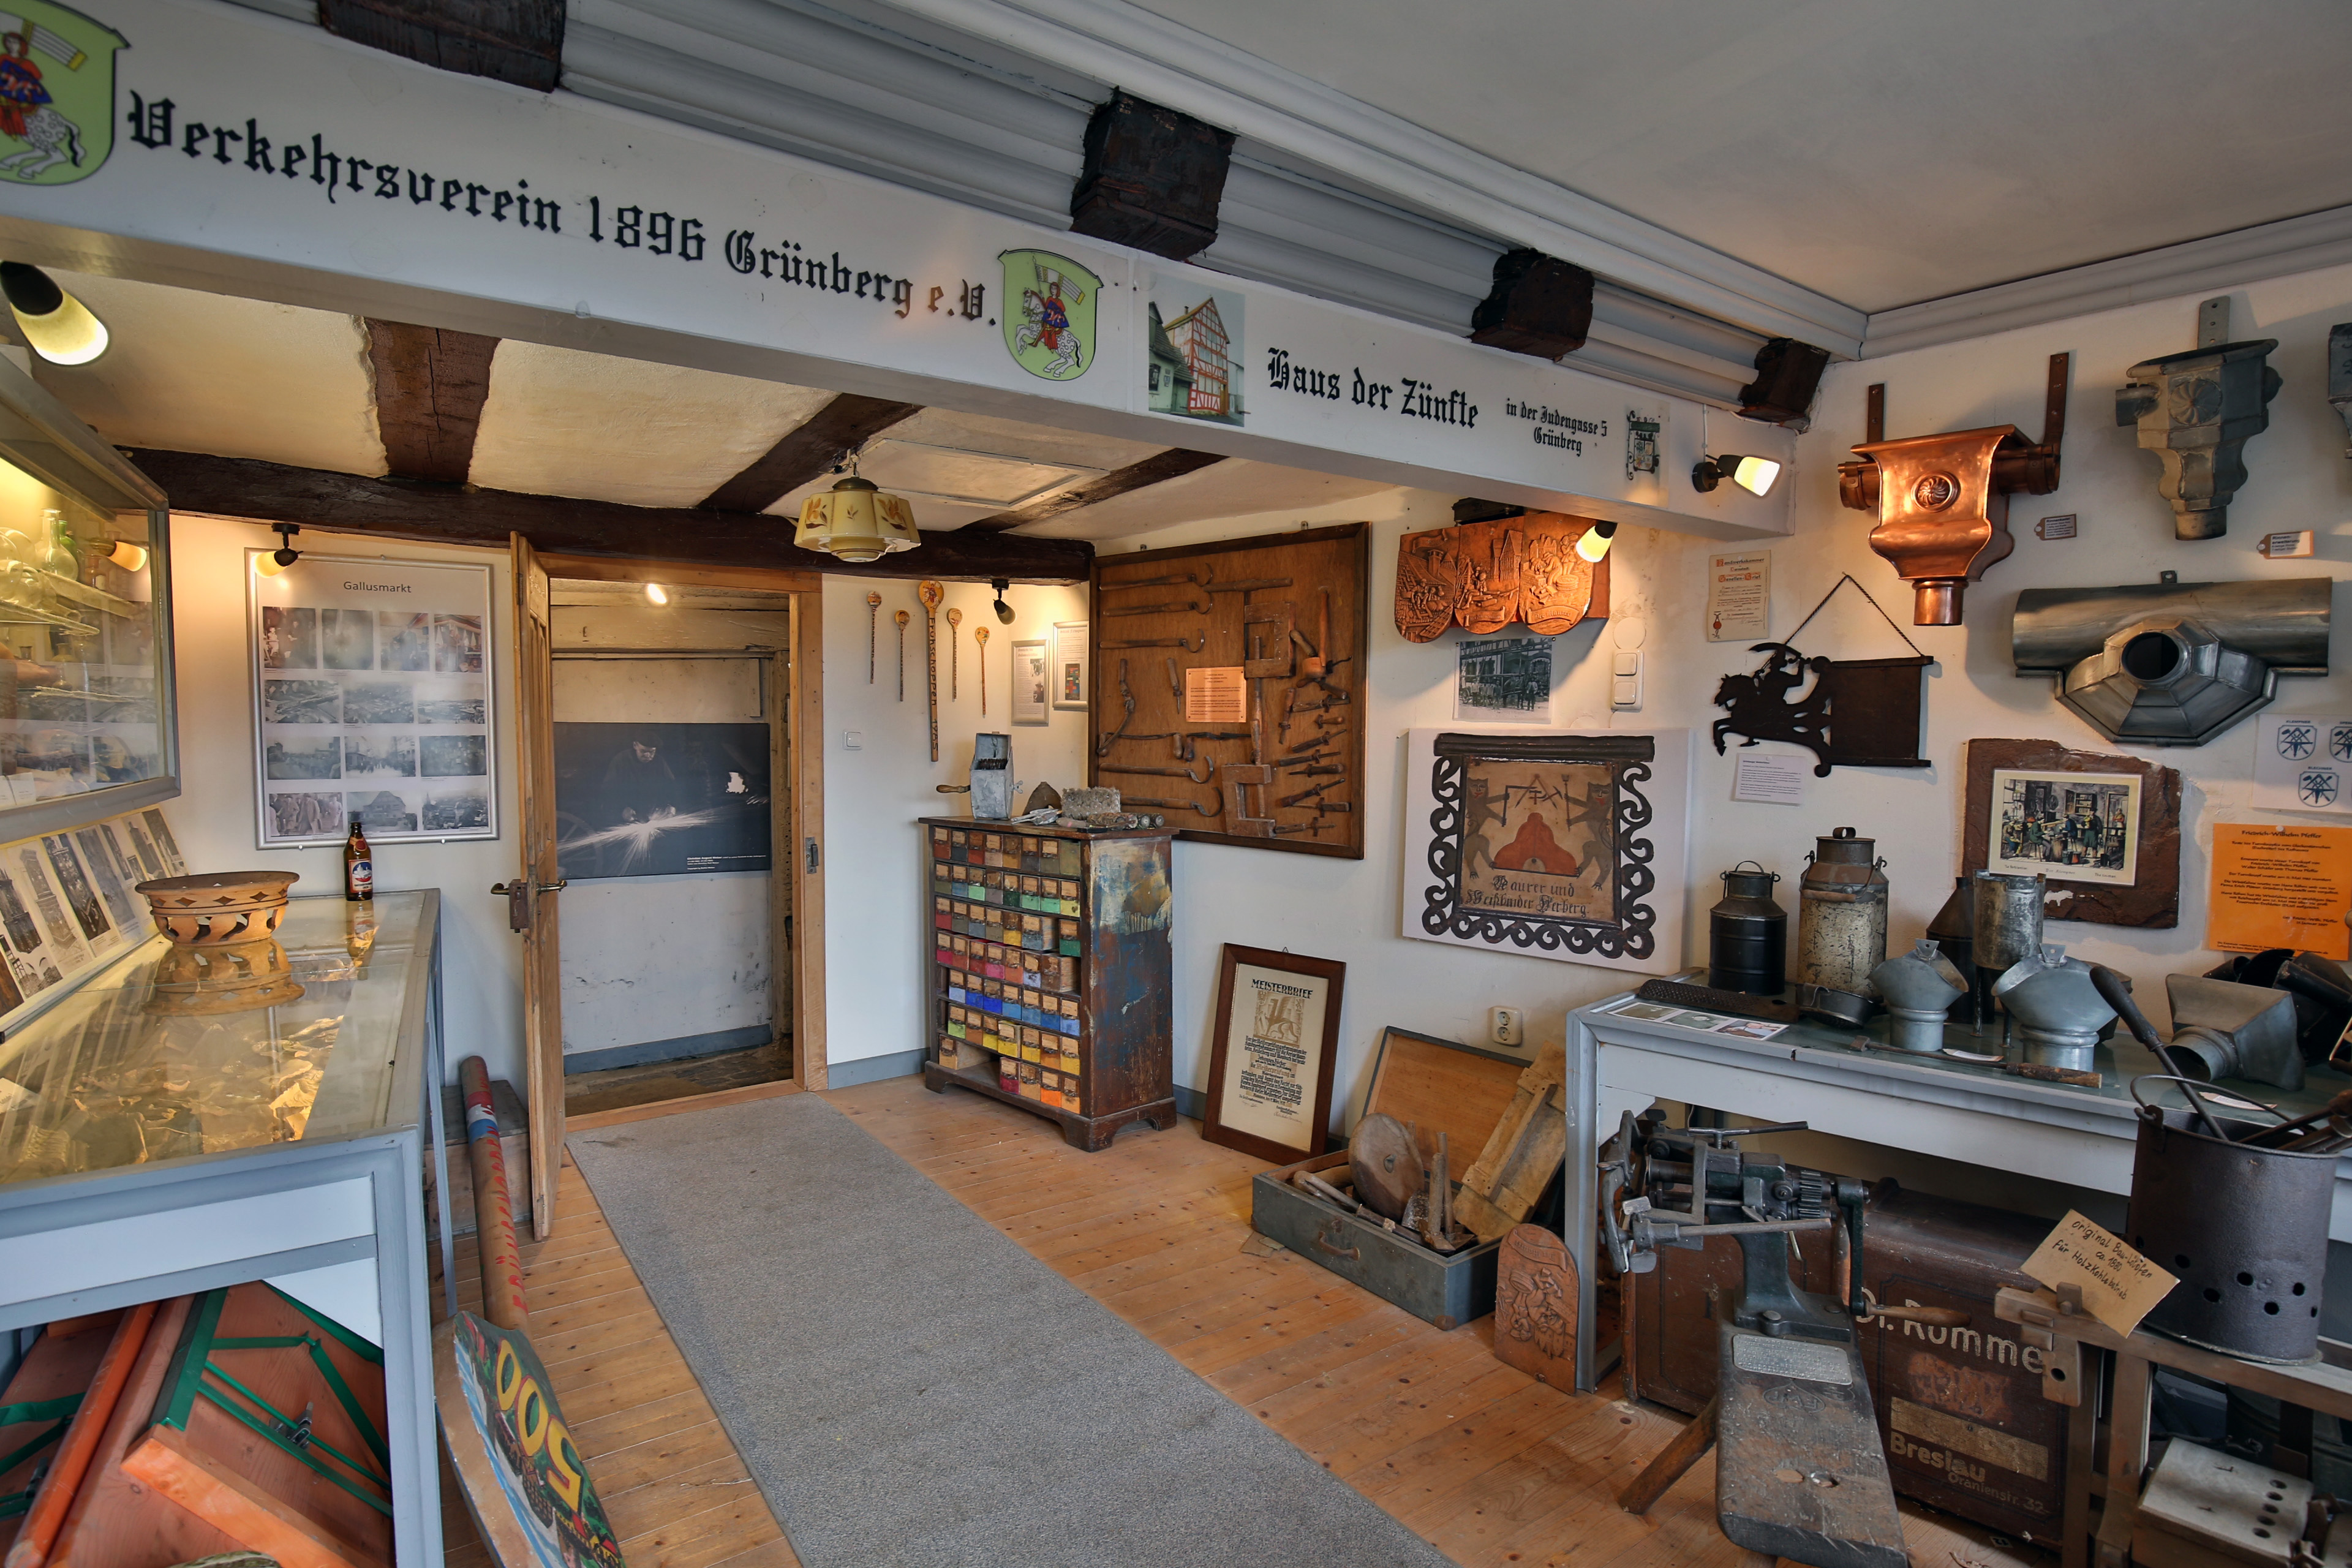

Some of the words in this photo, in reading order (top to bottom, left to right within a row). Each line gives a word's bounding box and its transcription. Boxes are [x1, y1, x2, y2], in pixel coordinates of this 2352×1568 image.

[127, 89, 564, 234] Verkehrsverein
[588, 196, 706, 261] 1896
[725, 230, 914, 319] Grünberg
[1267, 347, 1341, 401] Haus
[1351, 367, 1393, 411] der
[1400, 377, 1479, 429] Zünfte
[1506, 398, 1517, 417] in
[1520, 401, 1538, 420] der
[1541, 405, 1598, 435] Judengasse
[1601, 420, 1607, 437] 5
[1534, 426, 1582, 457] Grünberg
[343, 580, 412, 595] Gallusmarkt
[1550, 883, 1575, 897] und
[1251, 979, 1313, 999] MEISTERBRIEF
[2052, 1239, 2069, 1253] für
[2096, 1251, 2106, 1261] ca.
[2108, 1258, 2122, 1272] 1880
[1890, 1431, 1986, 1483] Breslau
